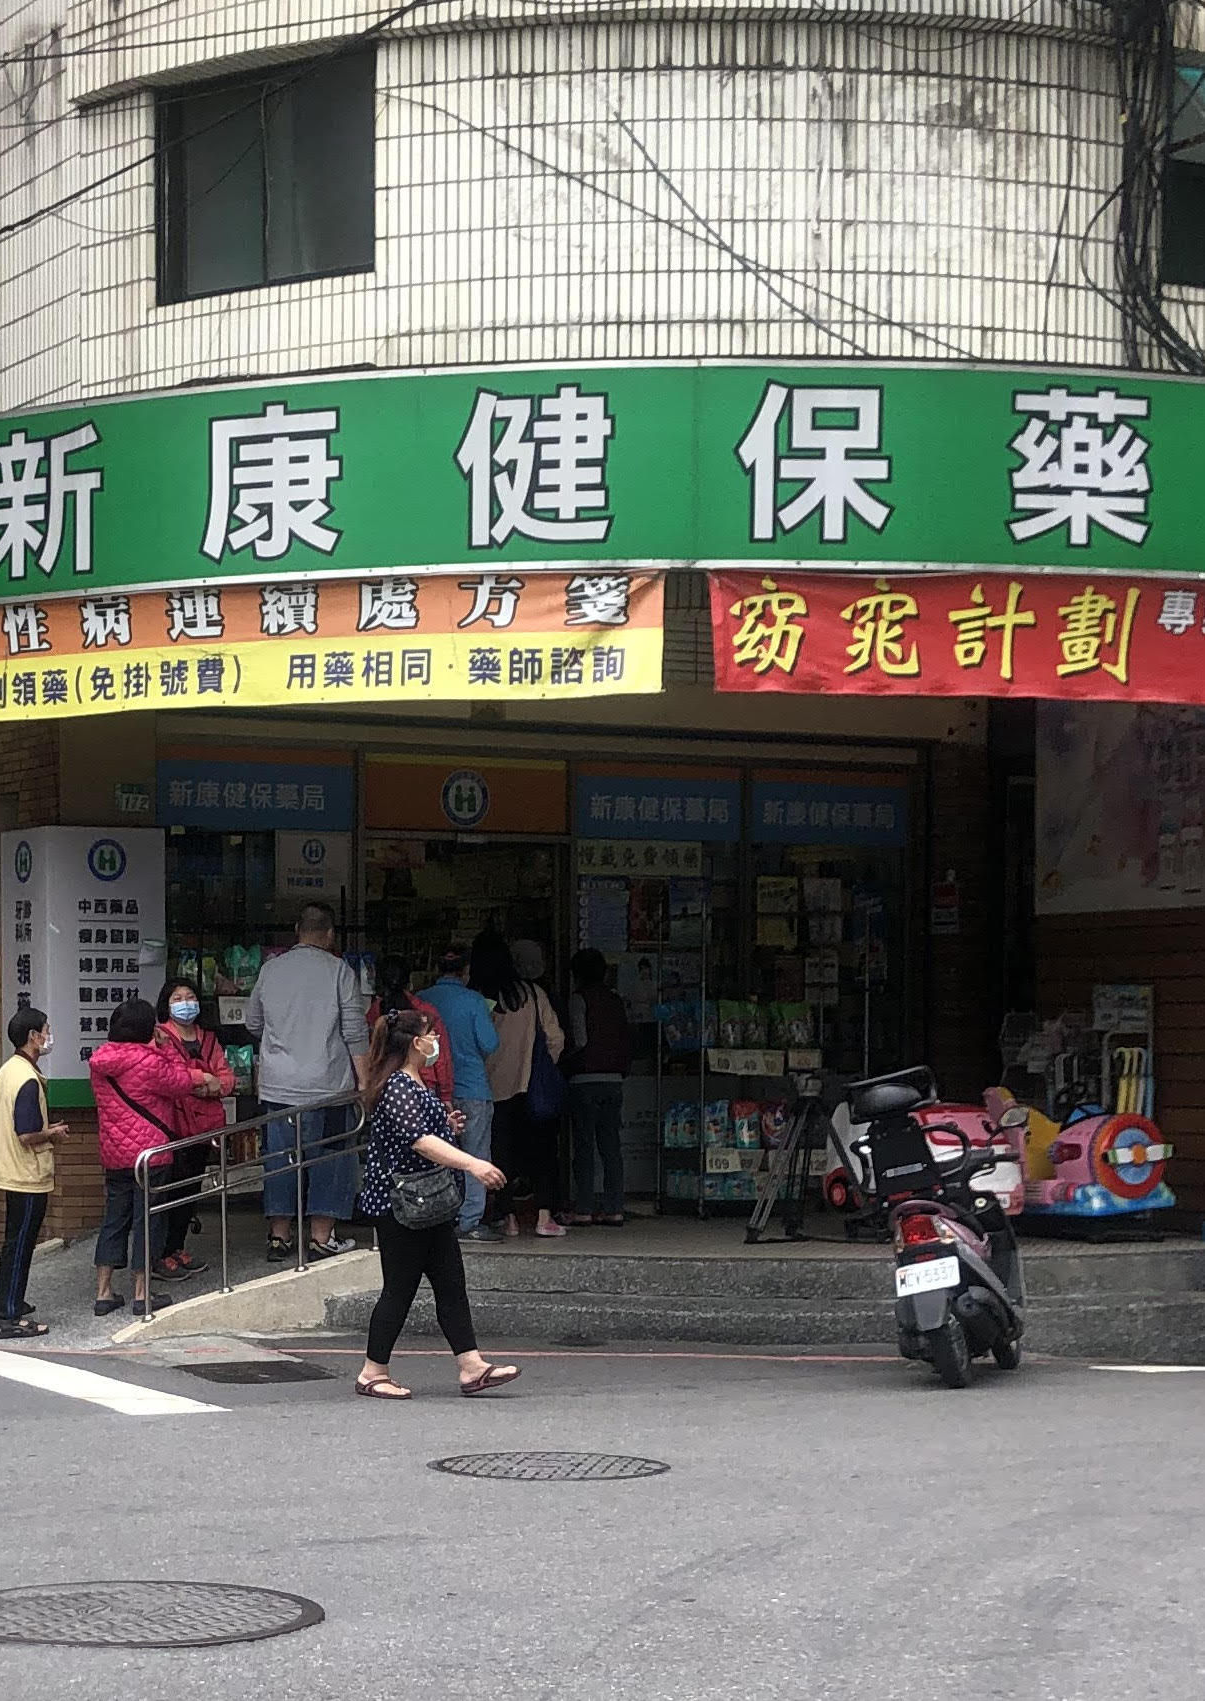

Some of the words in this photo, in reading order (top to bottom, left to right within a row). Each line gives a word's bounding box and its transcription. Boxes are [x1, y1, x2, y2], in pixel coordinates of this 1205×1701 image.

[1157, 589, 1205, 635] 專
[728, 575, 1142, 684] 窈窕計劃
[169, 779, 326, 812] 新康健保藥局
[589, 794, 730, 825] 新康健保藥局
[762, 800, 896, 832] 新康健保藥局
[78, 898, 139, 915] 中西藥品
[79, 957, 140, 973] 婦嬰用品
[226, 1008, 243, 1021] 49
